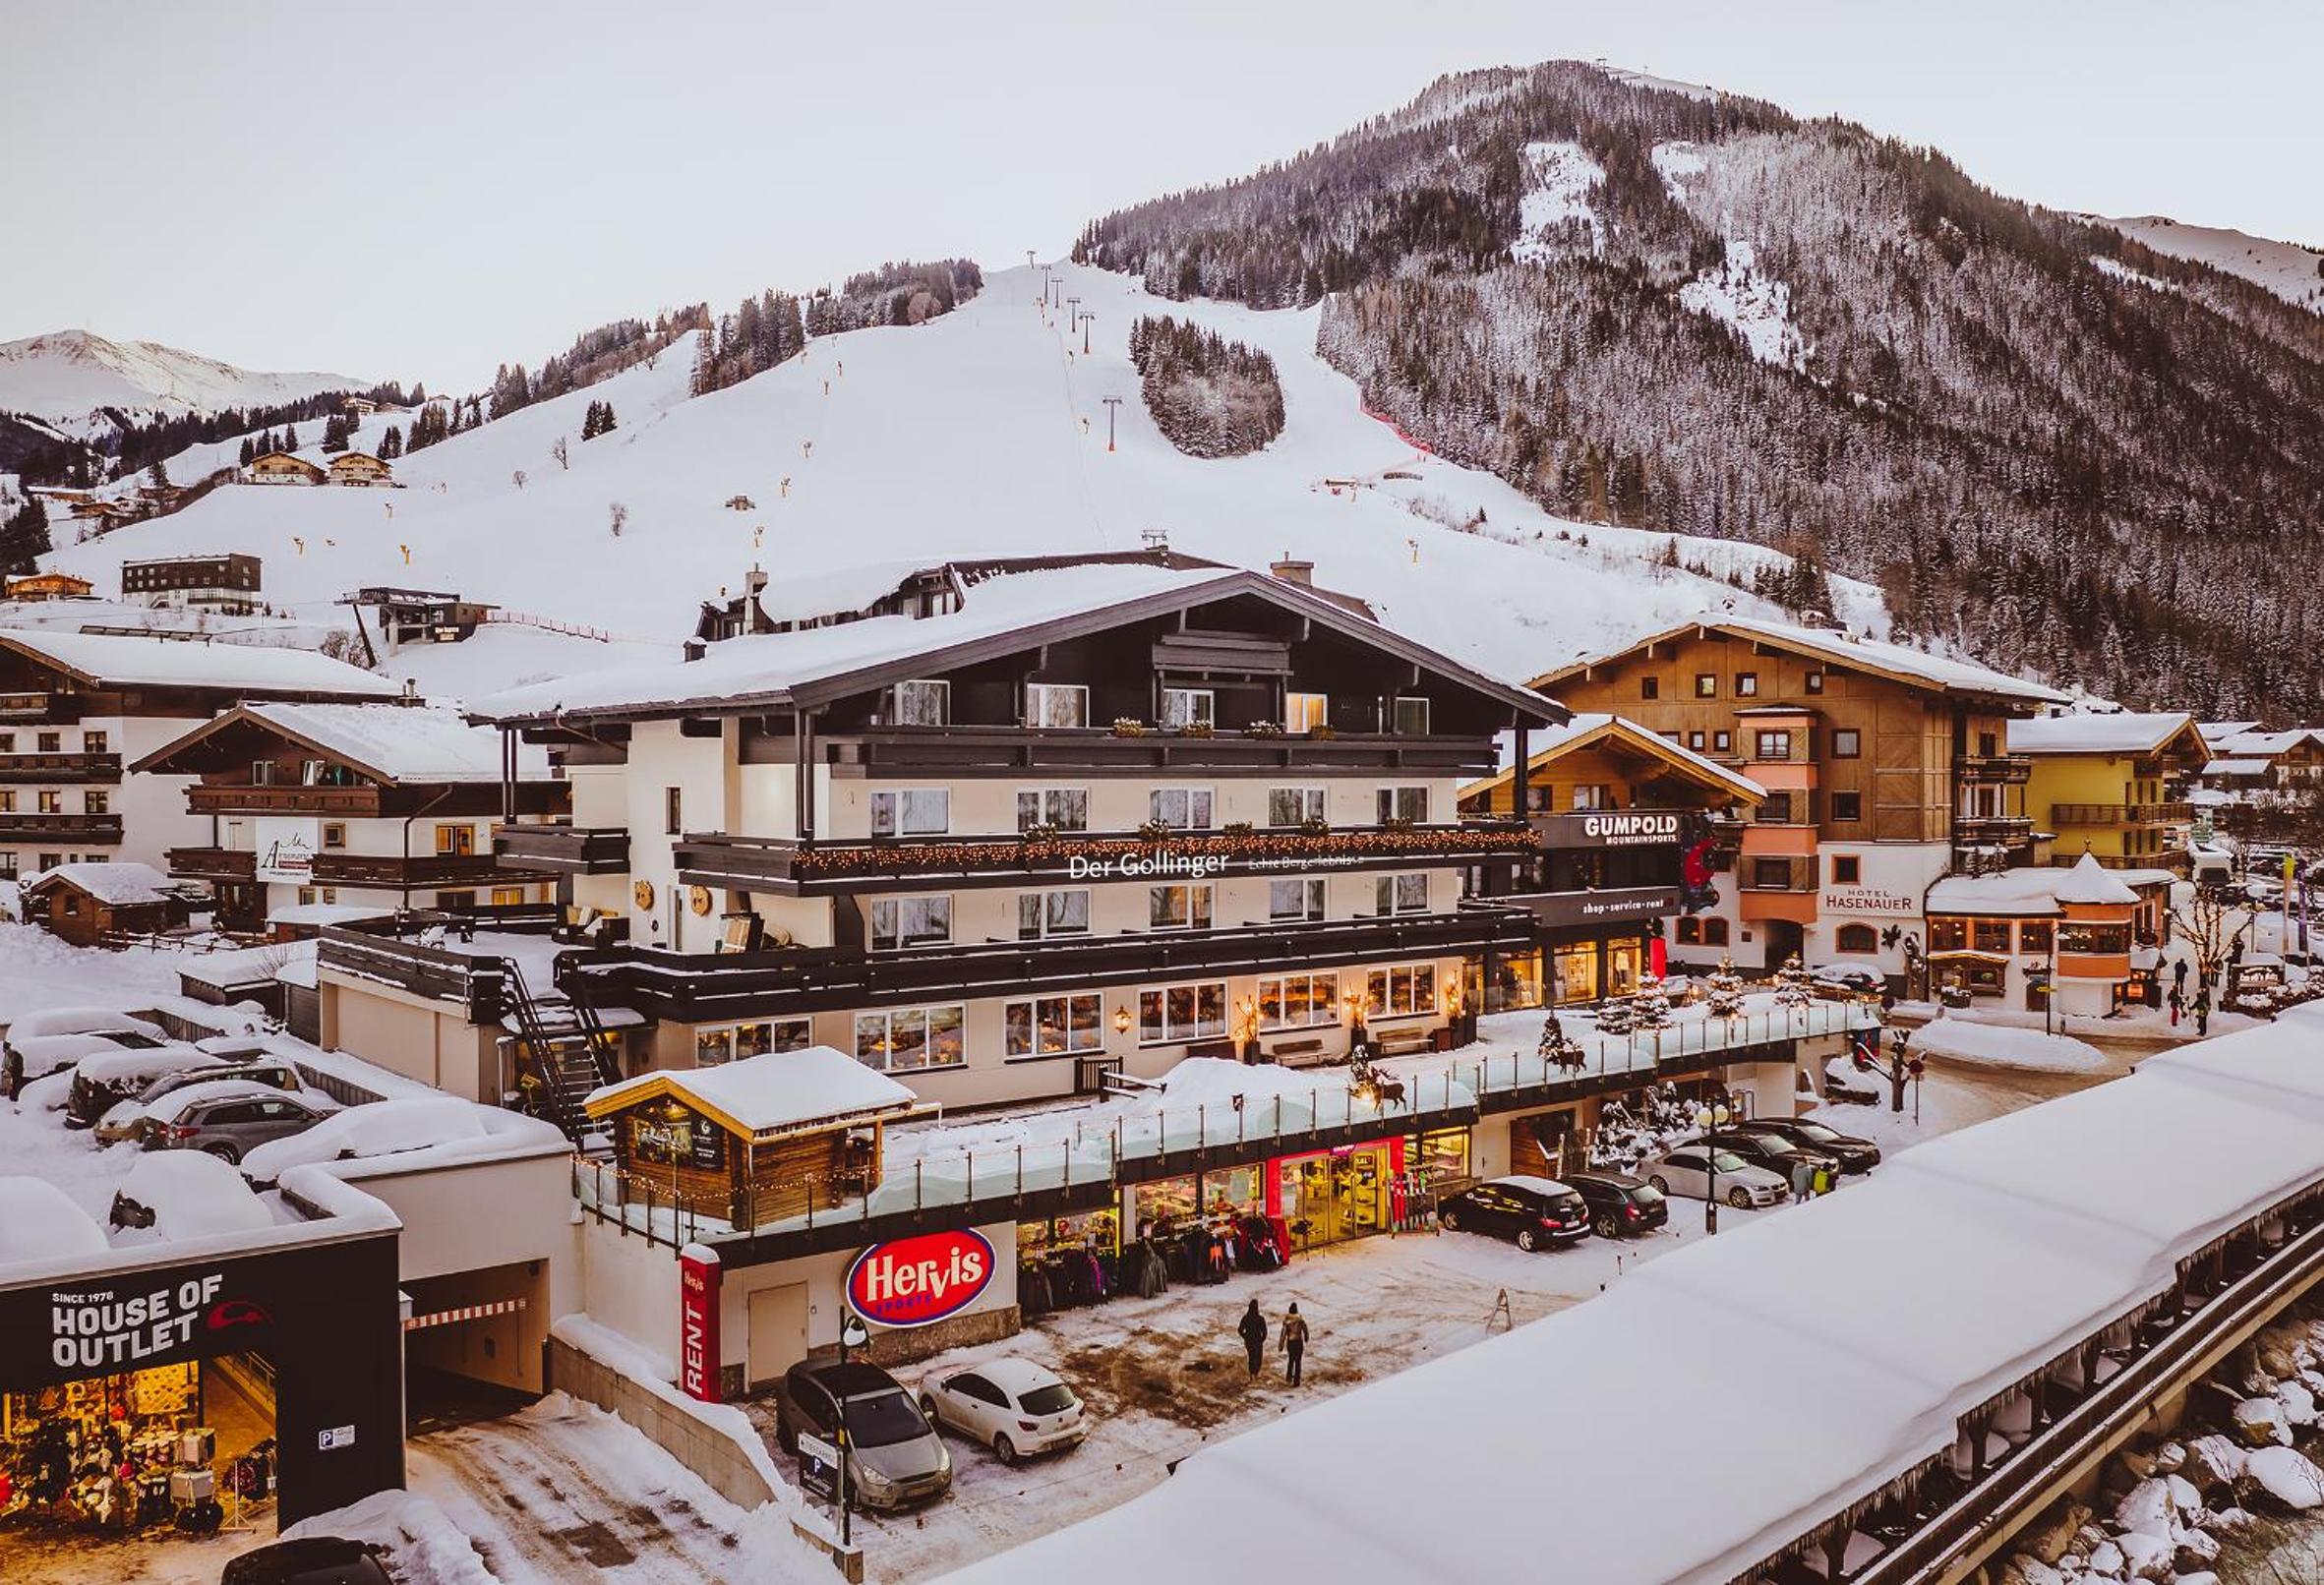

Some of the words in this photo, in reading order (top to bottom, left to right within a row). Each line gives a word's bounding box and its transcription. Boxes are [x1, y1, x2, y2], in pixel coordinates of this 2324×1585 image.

[1584, 815, 1678, 837] GUMPOLD
[1606, 835, 1677, 845] MOUNTAINSPORTS
[1070, 854, 1112, 879] Der
[1120, 850, 1228, 878] Gollinger
[1826, 895, 1912, 910] HASENAUER
[1847, 889, 1889, 898] HOTEL
[866, 1246, 983, 1303] Hervis
[52, 1293, 85, 1304] SINCE
[52, 1289, 169, 1336] HOUSE
[178, 1274, 223, 1310] OF
[52, 1311, 198, 1368] OUTLET
[686, 1301, 703, 1394] RENT
[322, 1433, 331, 1446] P
[813, 1457, 822, 1474] P
